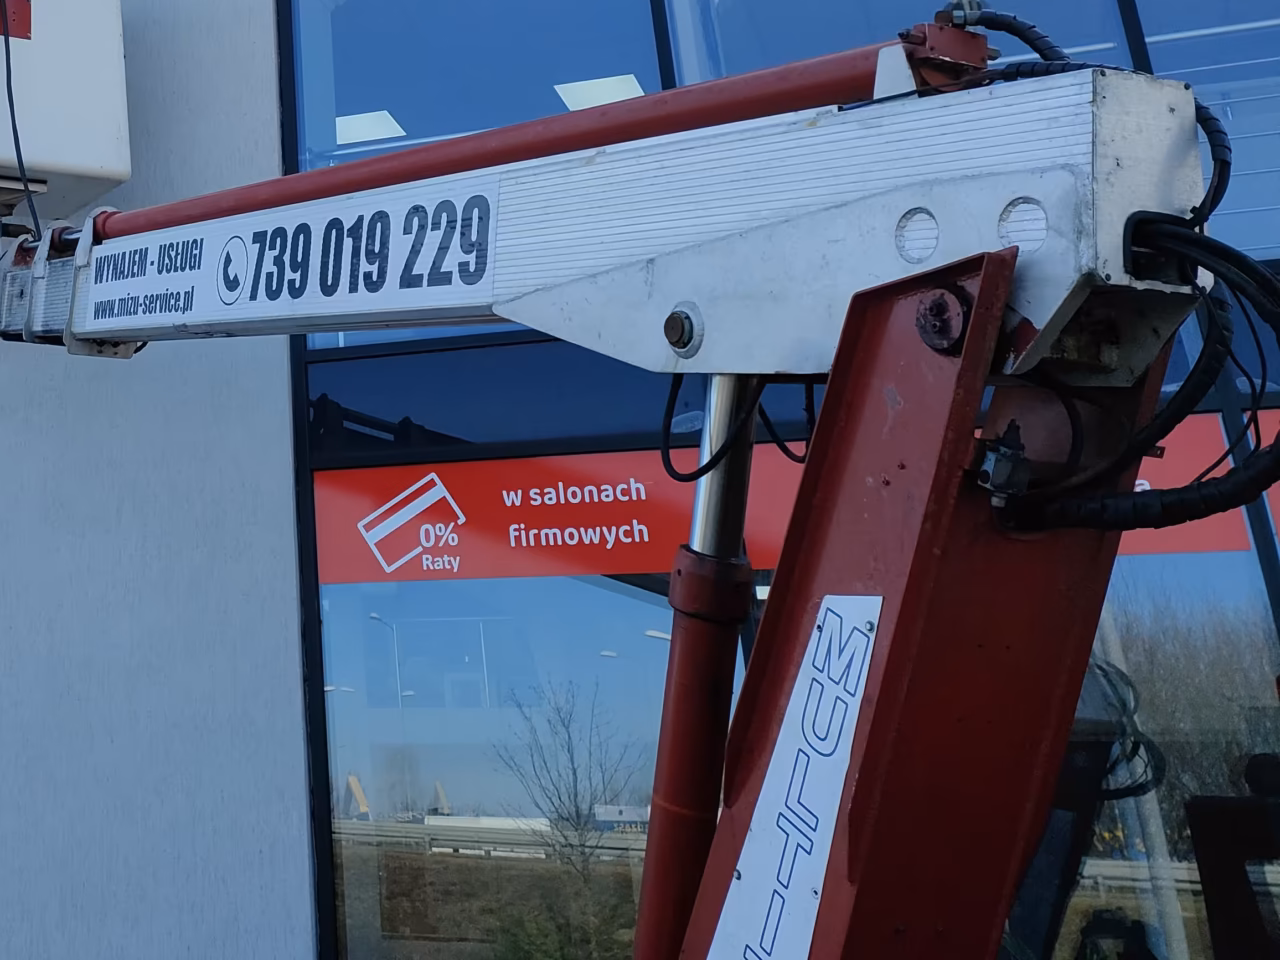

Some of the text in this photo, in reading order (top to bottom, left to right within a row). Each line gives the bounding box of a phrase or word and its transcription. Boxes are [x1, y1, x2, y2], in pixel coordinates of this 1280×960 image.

[94, 246, 149, 285] WYNAJEM
[156, 237, 204, 276] USŁUGI
[248, 194, 491, 301] 739 019 229
[93, 285, 195, 321] www.mizu-service.pl
[502, 478, 647, 507] w salonach
[419, 522, 459, 548] 0%
[509, 519, 650, 550] firmowych
[422, 553, 461, 573] Raty
[743, 606, 871, 960] MULTI
